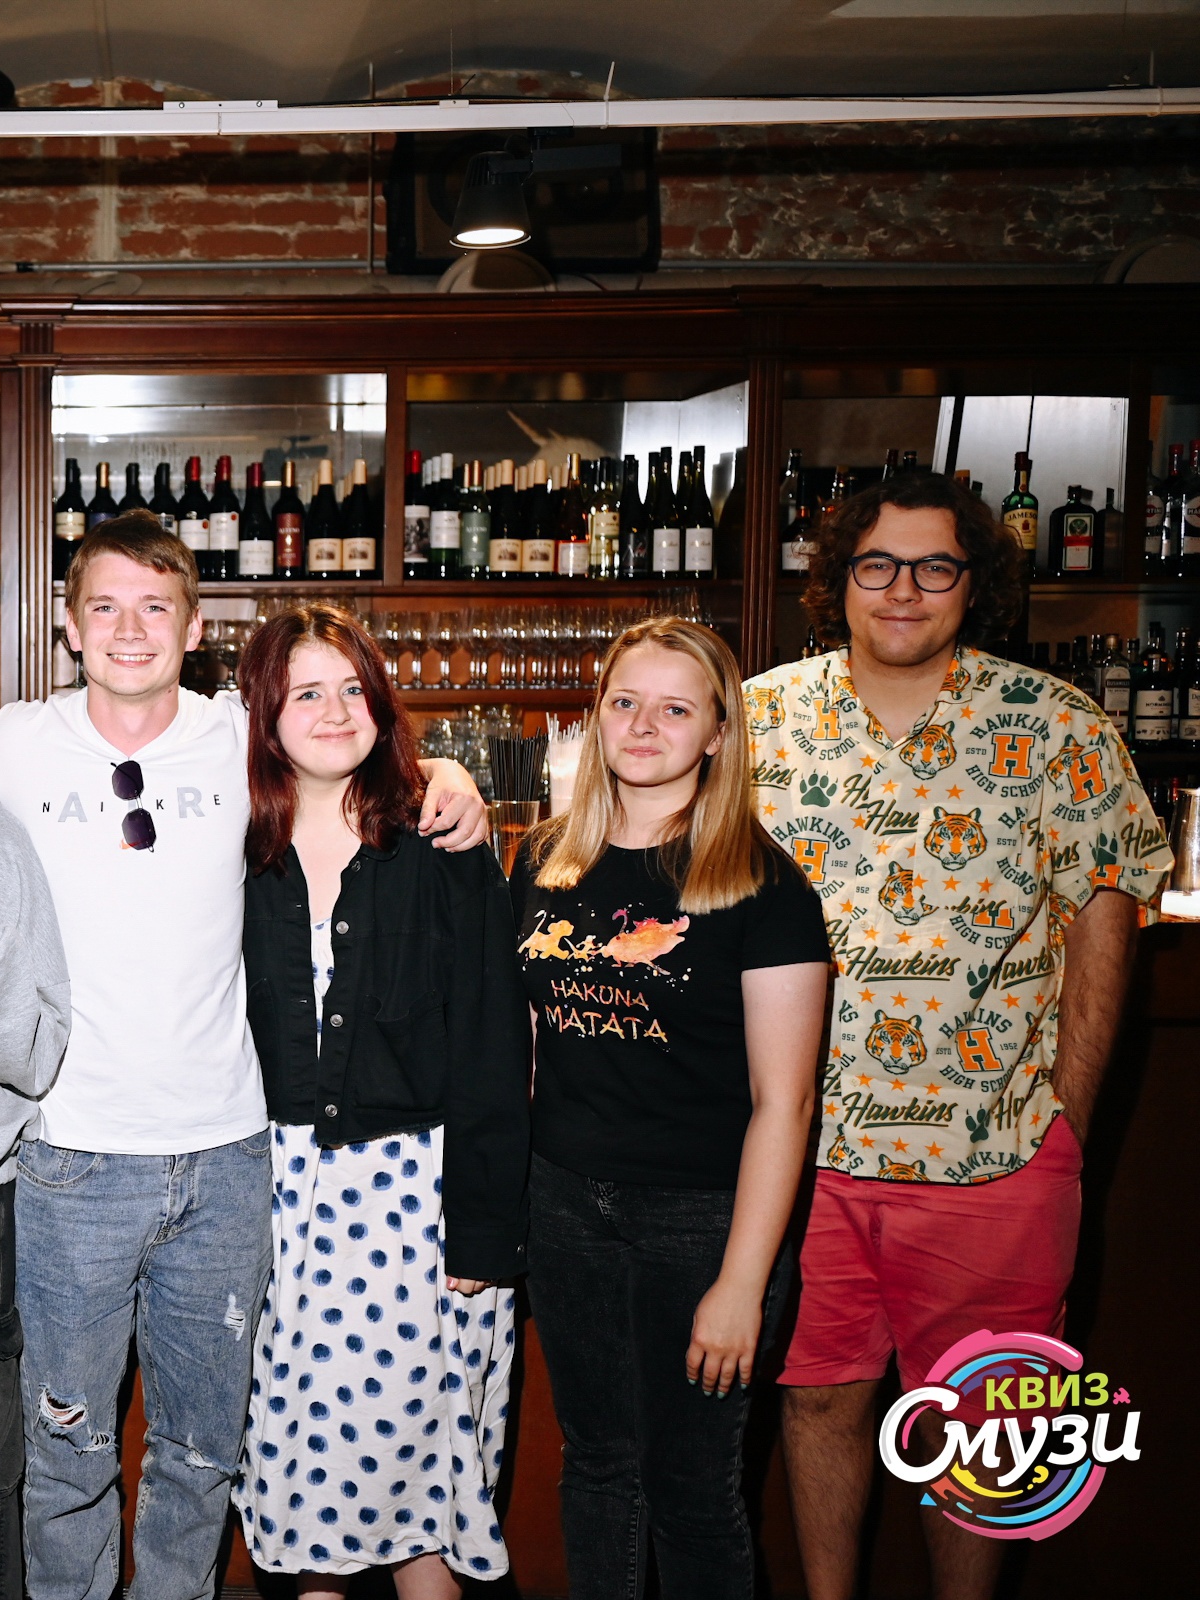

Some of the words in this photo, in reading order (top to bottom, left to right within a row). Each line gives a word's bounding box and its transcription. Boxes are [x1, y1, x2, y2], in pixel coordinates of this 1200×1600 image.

[1007, 511, 1038, 522] JAMESO
[793, 711, 812, 722] ESTD
[790, 728, 818, 756] HIGH
[965, 747, 987, 756] ESTD
[988, 732, 1036, 780] H
[965, 764, 998, 795] HIGH
[1051, 803, 1086, 823] HIGH
[771, 816, 851, 851] HAWKINS
[831, 860, 849, 868] 1952
[950, 914, 981, 945] HIGH
[845, 945, 961, 983] Hawkins
[551, 979, 649, 1011] HAKUNA
[545, 1004, 668, 1043] MATATA
[955, 1027, 1004, 1073] H
[1000, 1042, 1018, 1051] 1952
[939, 1064, 976, 1090] HIGH
[842, 1091, 958, 1129] Hawkins
